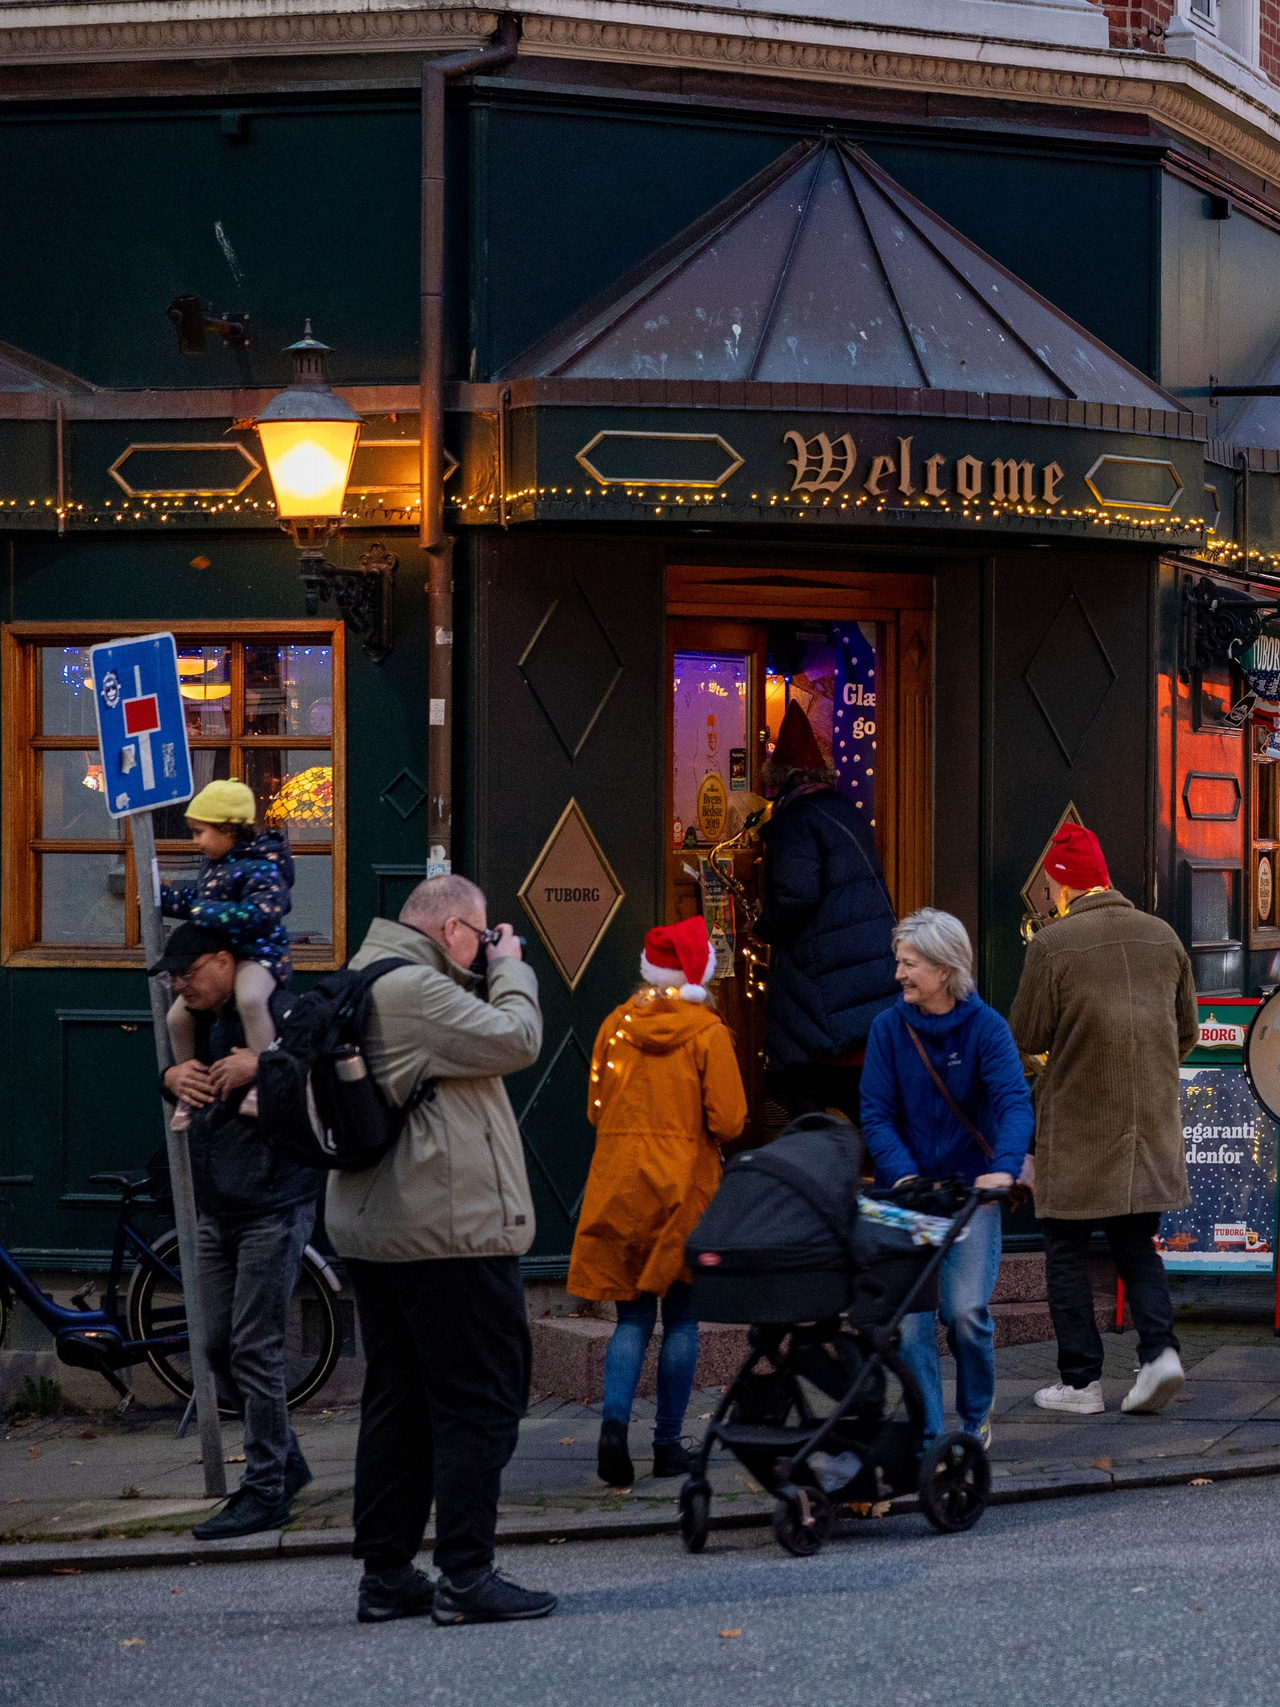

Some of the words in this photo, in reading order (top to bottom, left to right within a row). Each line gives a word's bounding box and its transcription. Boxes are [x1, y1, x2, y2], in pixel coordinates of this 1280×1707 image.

[783, 430, 1065, 505] Welcome
[843, 683, 876, 706] Glæ
[852, 717, 876, 739] go
[545, 888, 600, 902] TUBORG
[1199, 1028, 1236, 1041] BORG
[1182, 1121, 1255, 1143] egaranti
[1185, 1144, 1244, 1164] denfor
[1215, 1228, 1244, 1236] TUBORG
